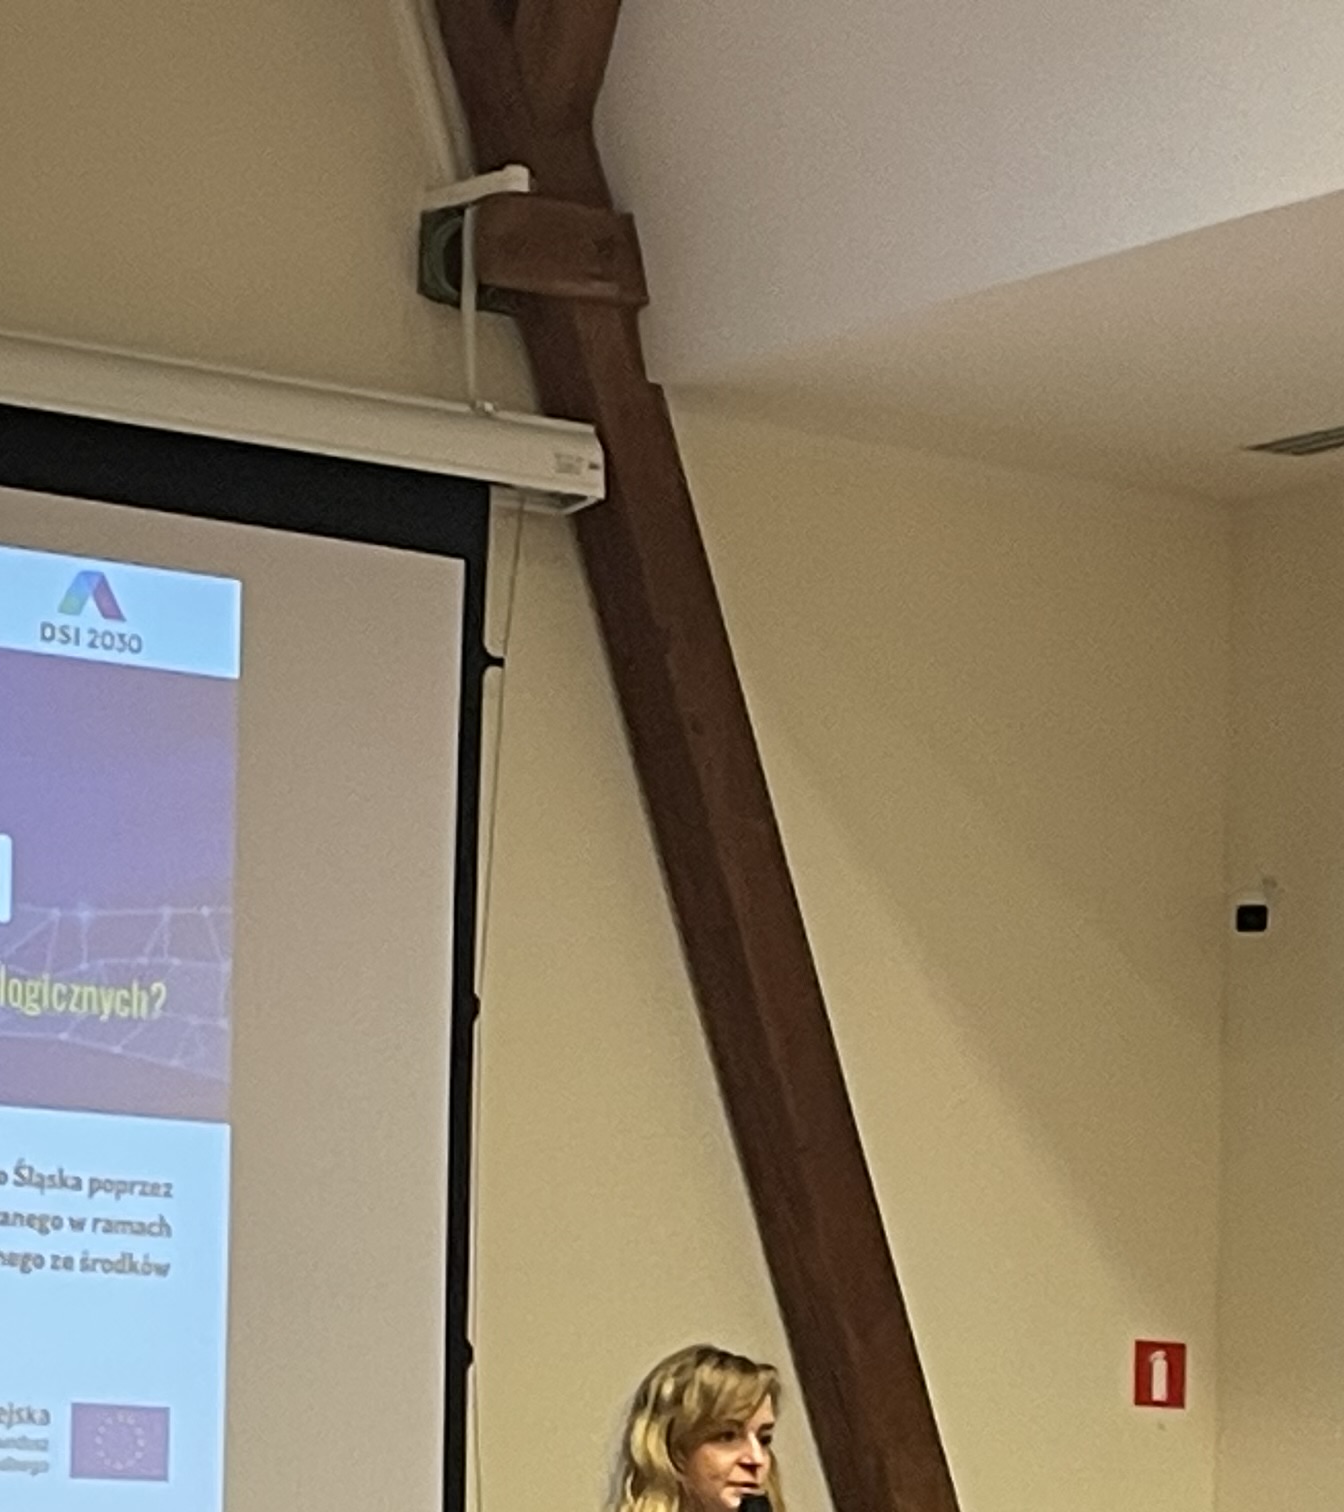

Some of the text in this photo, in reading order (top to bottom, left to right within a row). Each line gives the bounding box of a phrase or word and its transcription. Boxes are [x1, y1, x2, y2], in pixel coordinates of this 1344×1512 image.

[39, 621, 143, 655] DSI 2030
[13, 1158, 83, 1195] Śląska
[88, 1174, 174, 1201] poprzez
[68, 1214, 86, 1232] w
[90, 1213, 173, 1239] ramach
[50, 1253, 75, 1272] ze
[79, 1249, 172, 1279] środków
